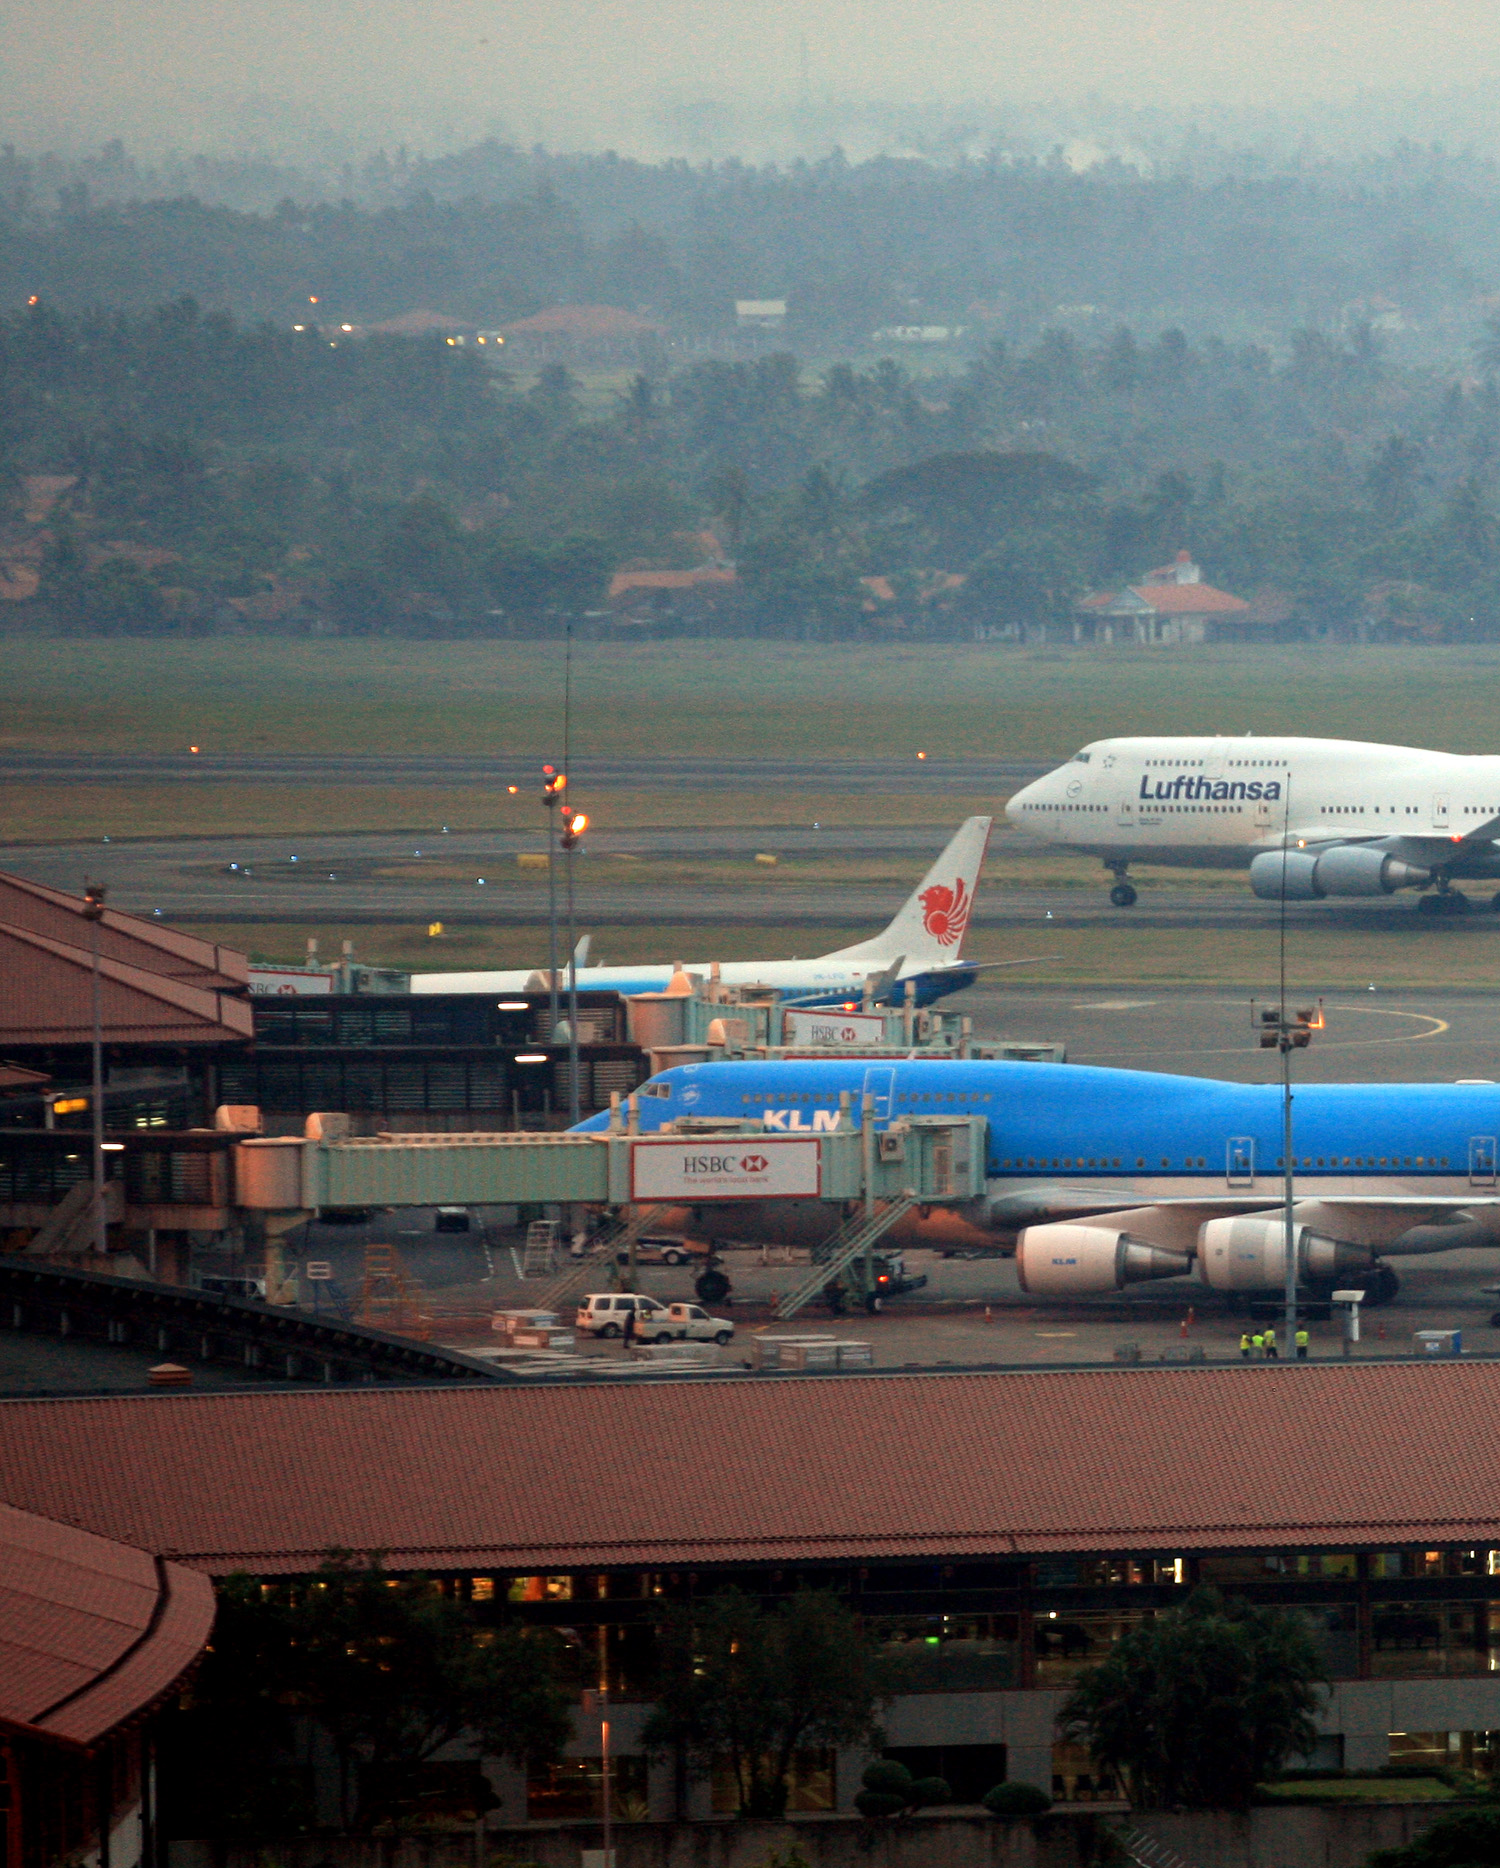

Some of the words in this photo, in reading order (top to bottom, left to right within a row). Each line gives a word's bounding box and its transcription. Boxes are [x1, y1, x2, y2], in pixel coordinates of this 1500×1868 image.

[1139, 774, 1281, 801] Lufthansa
[811, 1024, 839, 1041] HSBC
[684, 1155, 736, 1173] HSBC
